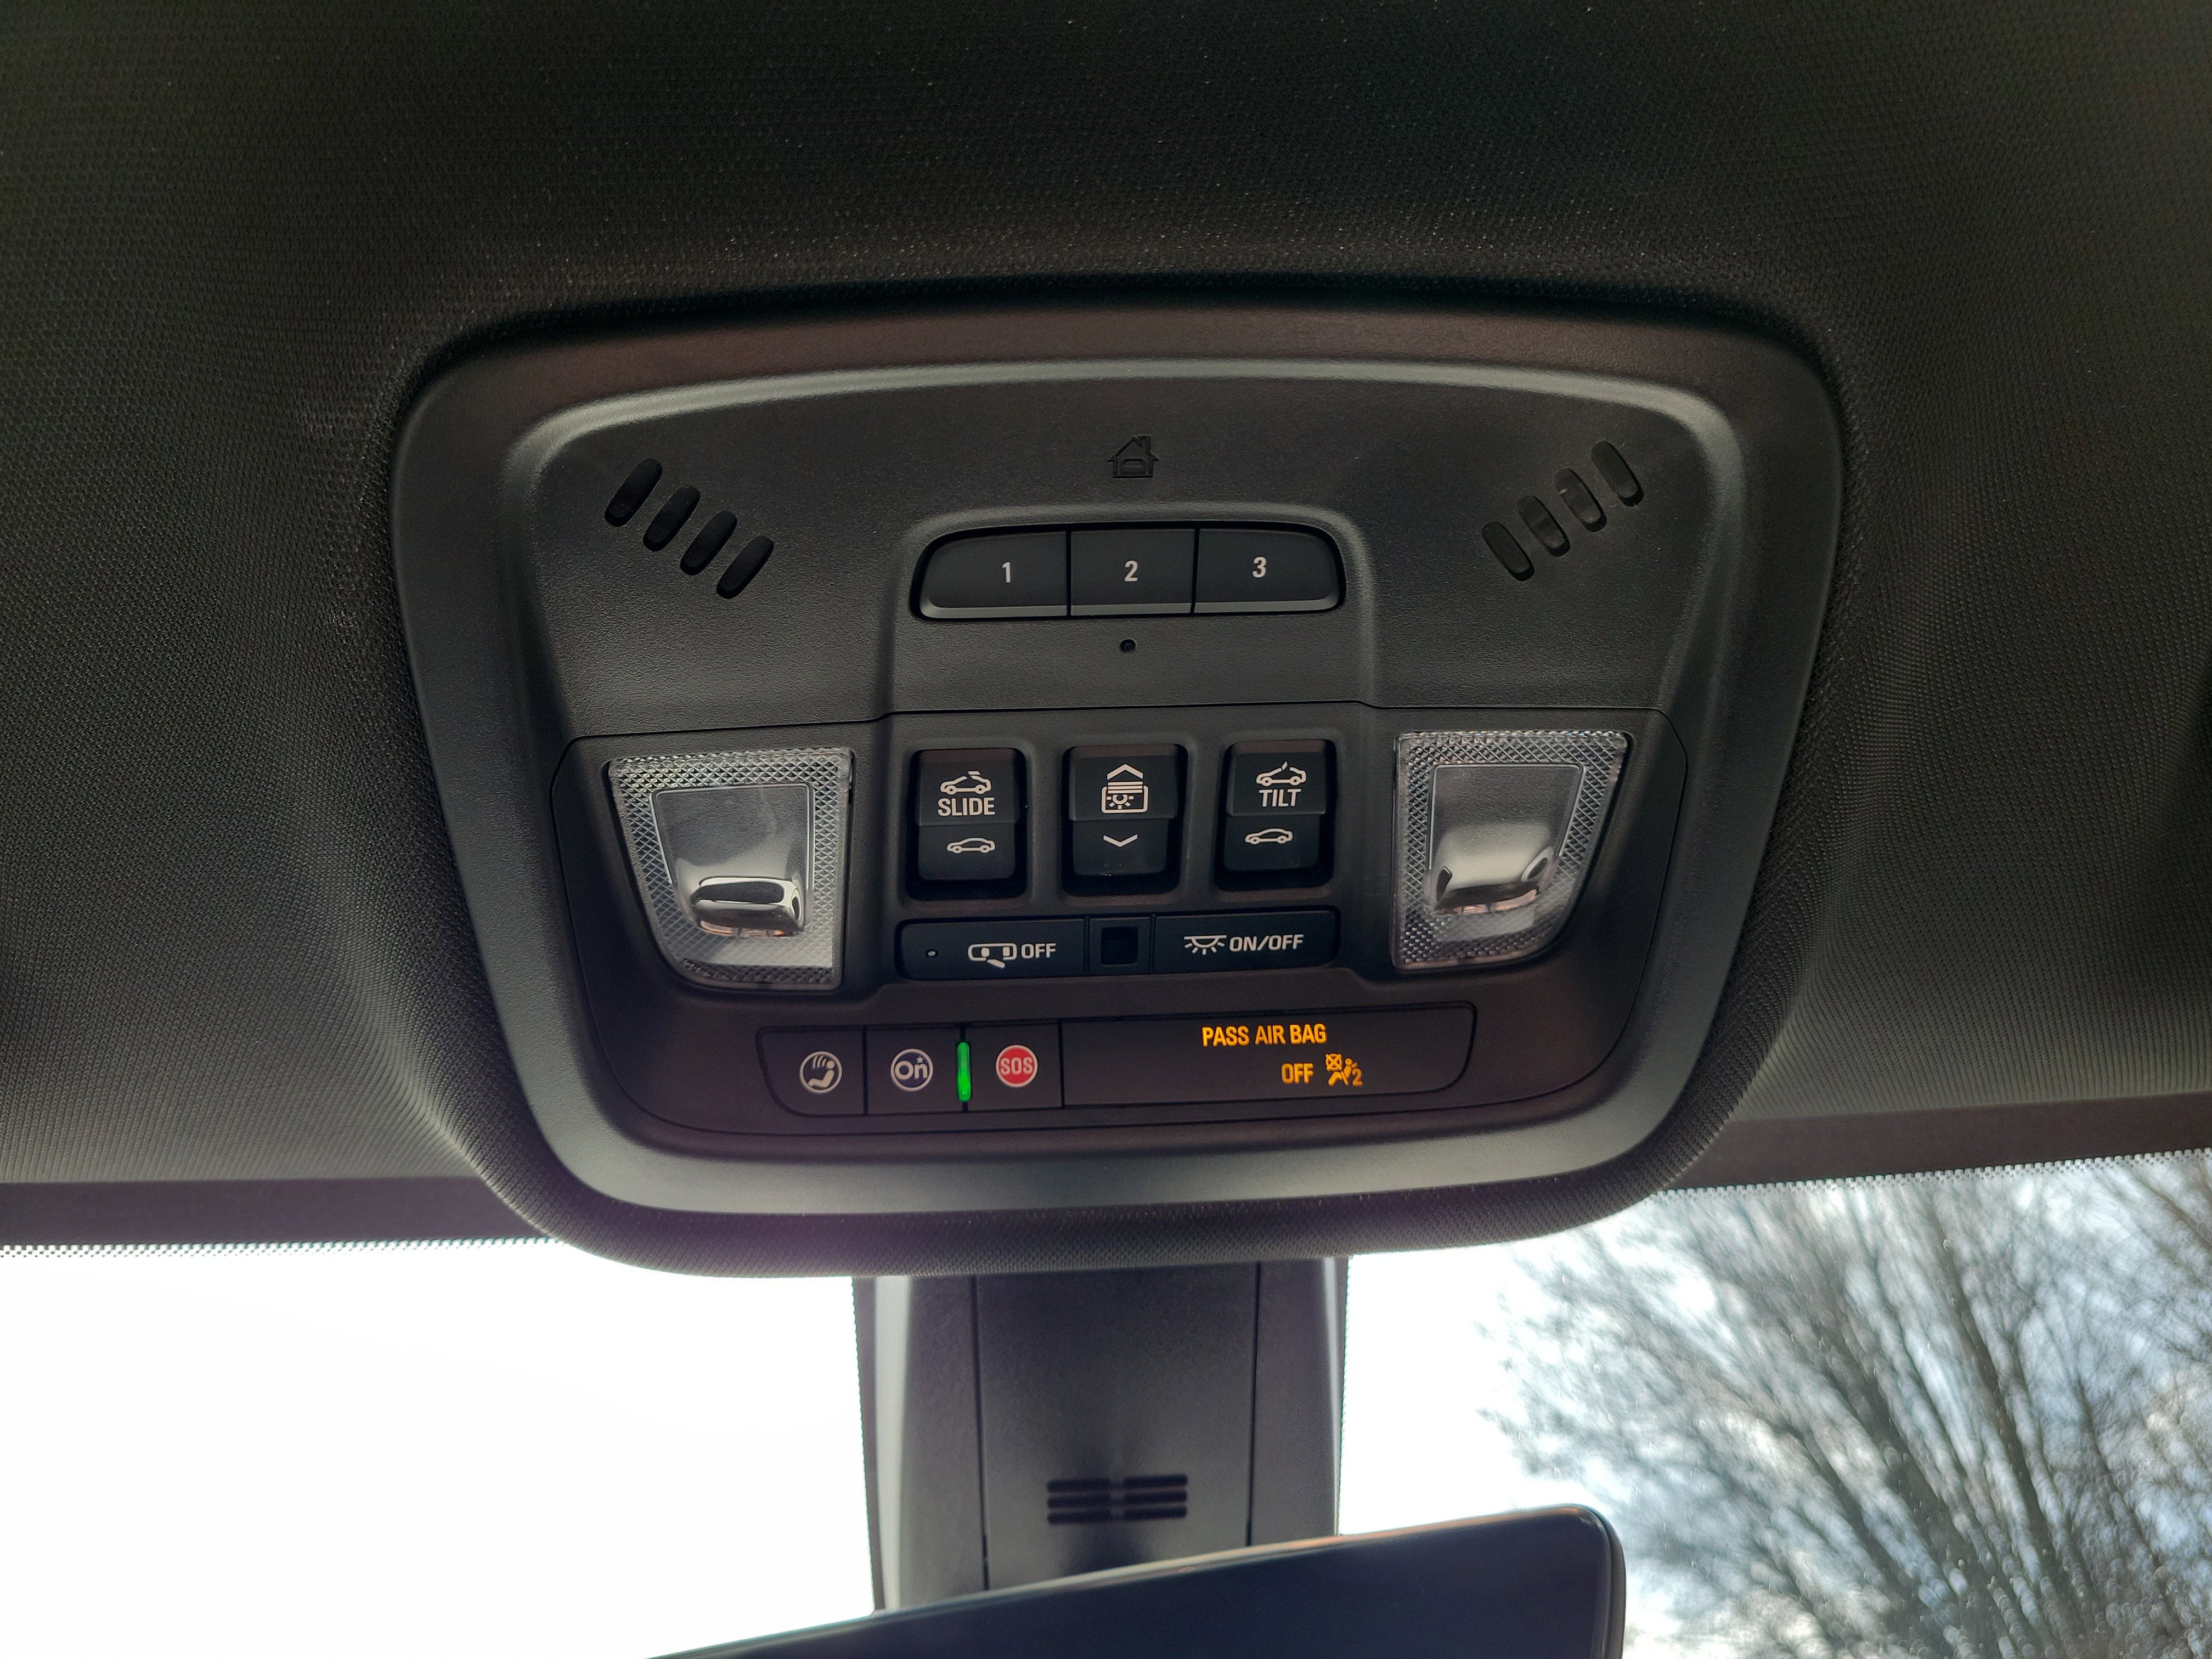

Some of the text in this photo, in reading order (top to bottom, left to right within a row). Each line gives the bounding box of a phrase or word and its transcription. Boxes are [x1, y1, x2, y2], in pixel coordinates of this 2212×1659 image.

[1002, 562, 1011, 583] 1
[1124, 560, 1138, 582] 2
[1252, 556, 1266, 578] 3
[938, 797, 995, 816] SLIDE
[1259, 788, 1301, 808] TILT
[1021, 943, 1056, 959] OFF
[1229, 934, 1304, 952] ON/OFF
[1202, 1023, 1327, 1047] PASS AIR BAG
[1000, 1057, 1033, 1075] SOS
[1281, 1063, 1314, 1084] OFF
